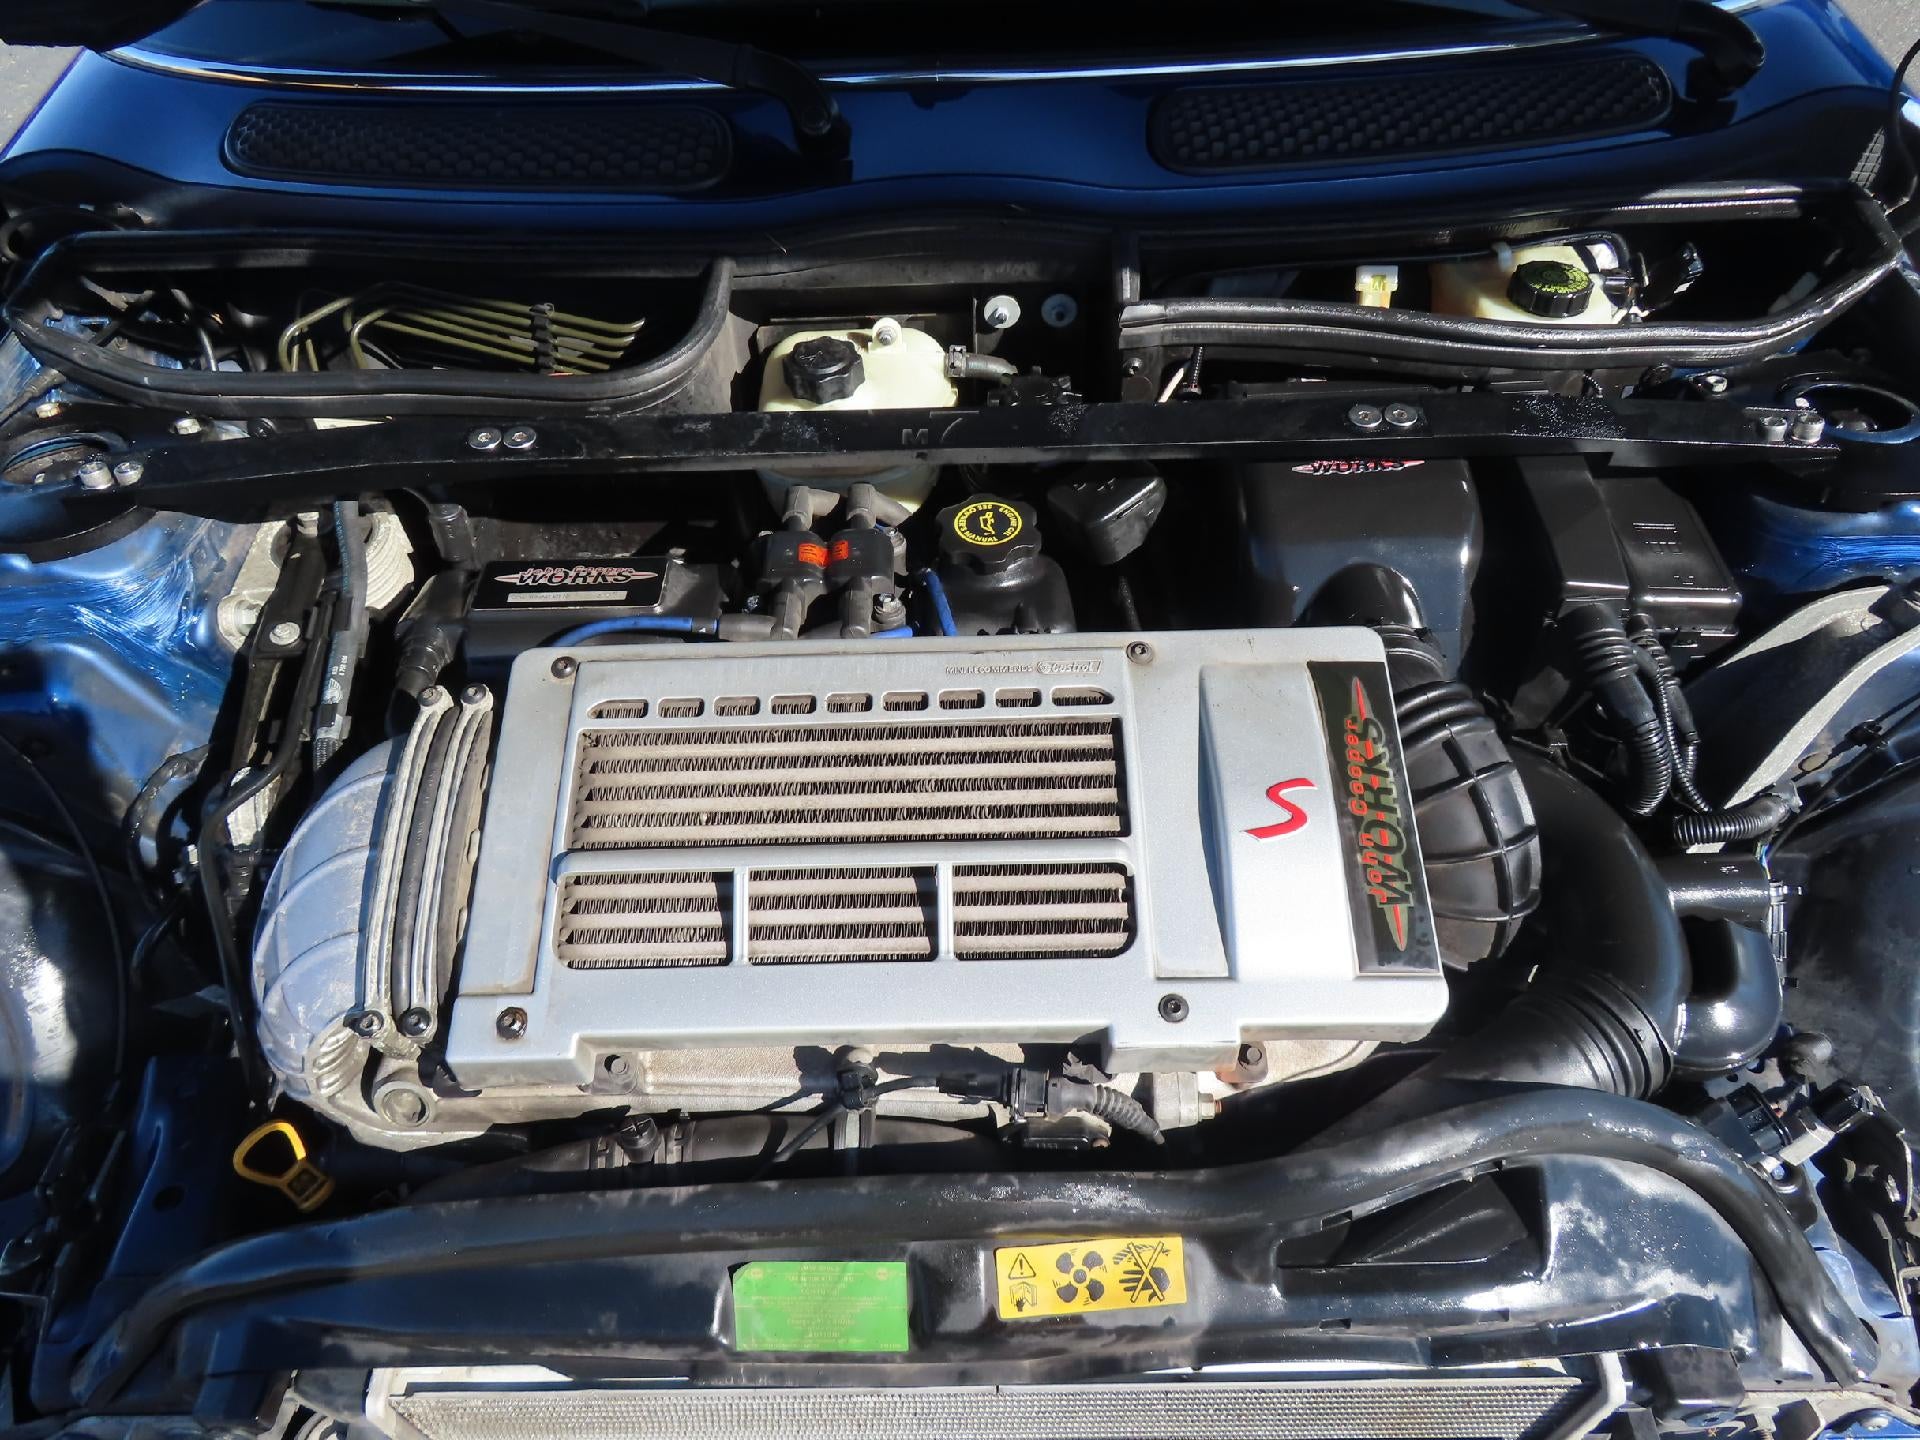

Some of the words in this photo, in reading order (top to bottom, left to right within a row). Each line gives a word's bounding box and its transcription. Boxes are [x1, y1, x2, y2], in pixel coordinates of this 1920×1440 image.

[963, 530, 999, 542] MANUAL
[999, 507, 1018, 527] ENGINE
[516, 569, 635, 586] WORKS
[967, 664, 1033, 675] RECOMMENDS
[1048, 660, 1093, 674] Castrol
[1344, 714, 1369, 817] Cooper
[1240, 778, 1319, 842] S
[1359, 716, 1415, 909] WORKS
[1359, 833, 1387, 904] John
